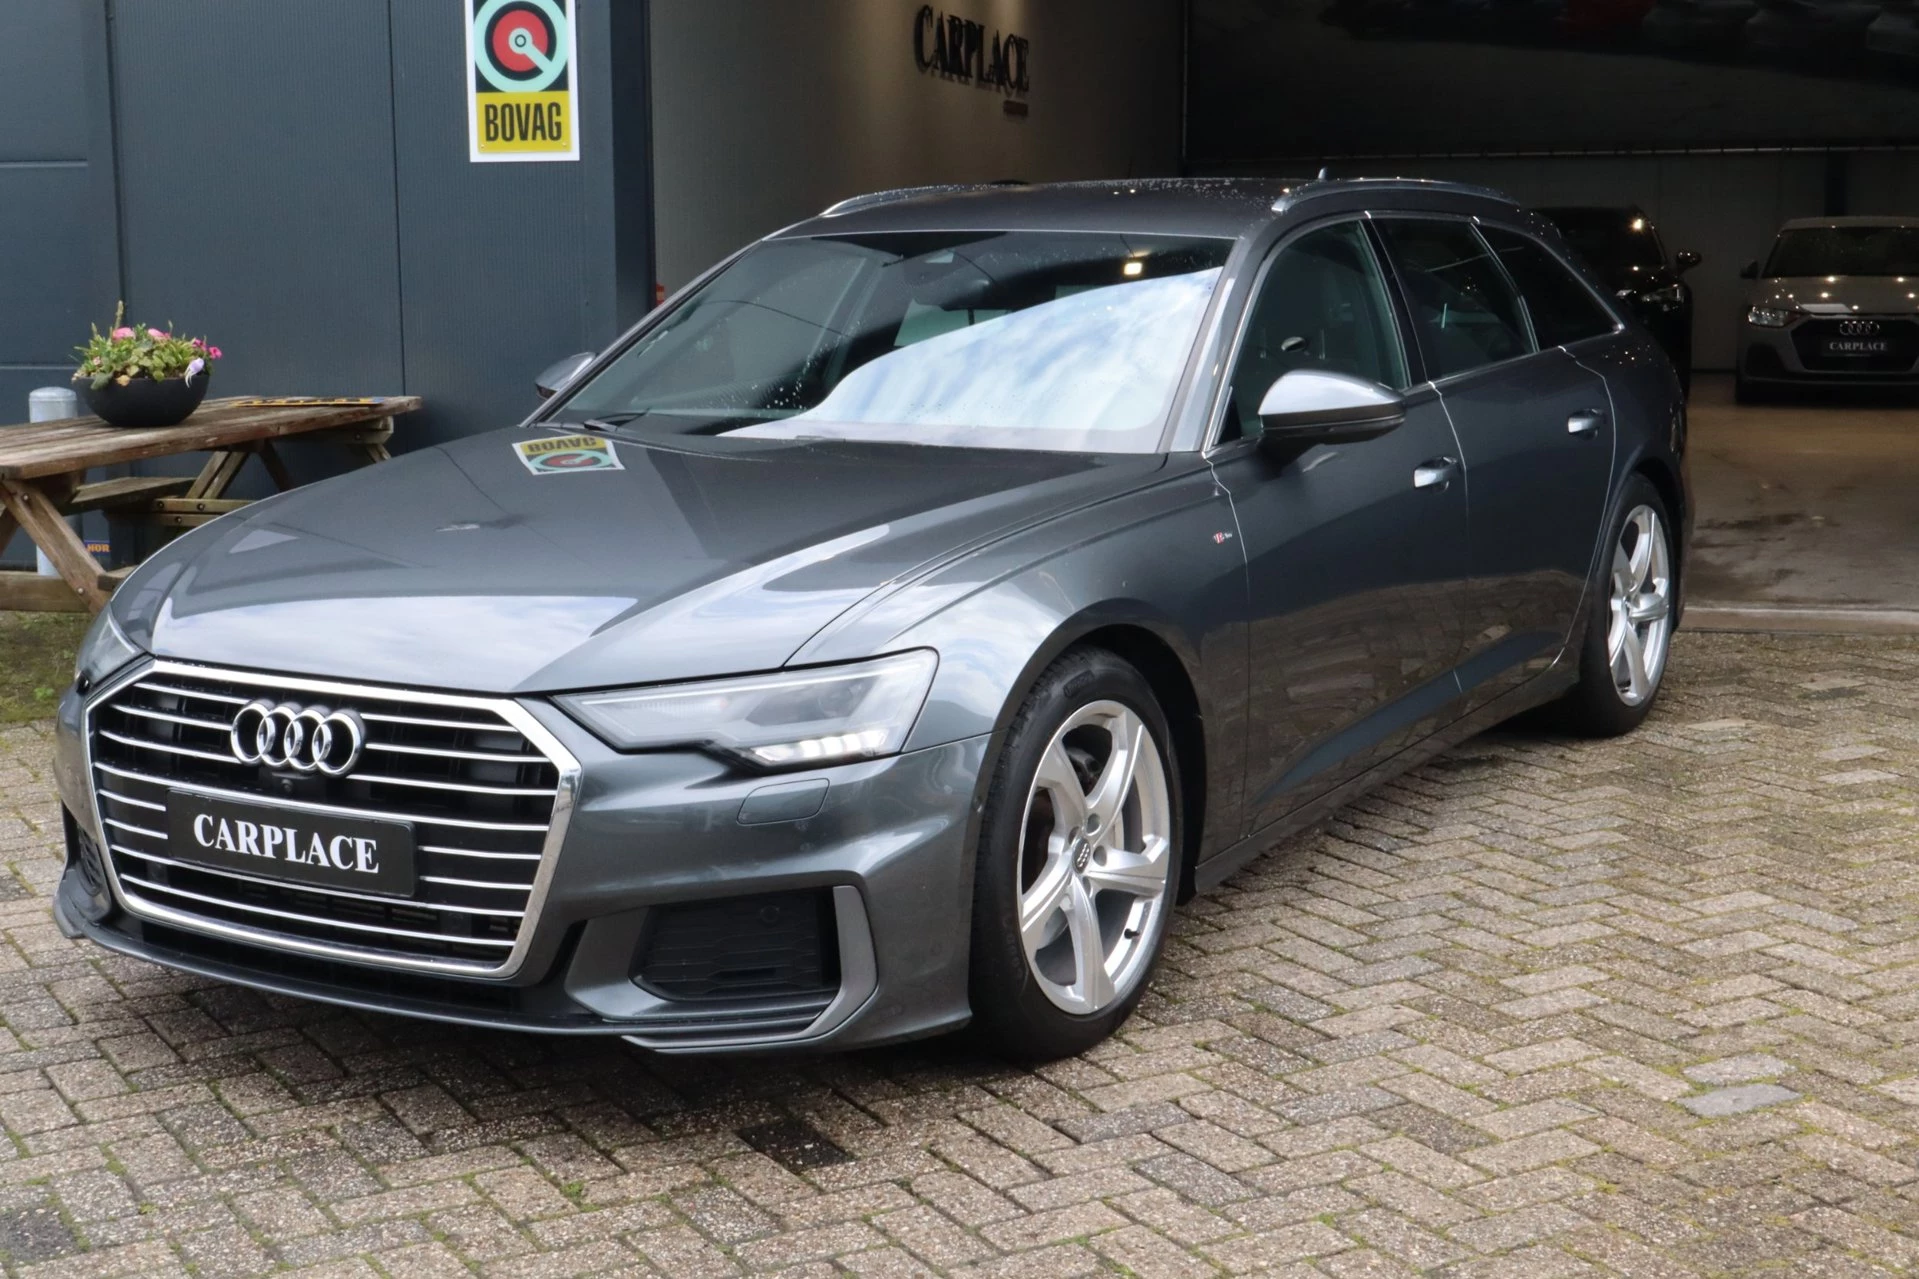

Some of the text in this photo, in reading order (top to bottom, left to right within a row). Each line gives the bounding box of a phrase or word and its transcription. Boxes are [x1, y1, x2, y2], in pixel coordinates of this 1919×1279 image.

[914, 4, 1029, 92] CARPLACE
[484, 102, 562, 142] BOVAG
[1829, 341, 1887, 351] CARPLACE
[193, 813, 380, 874] CARPLACE
